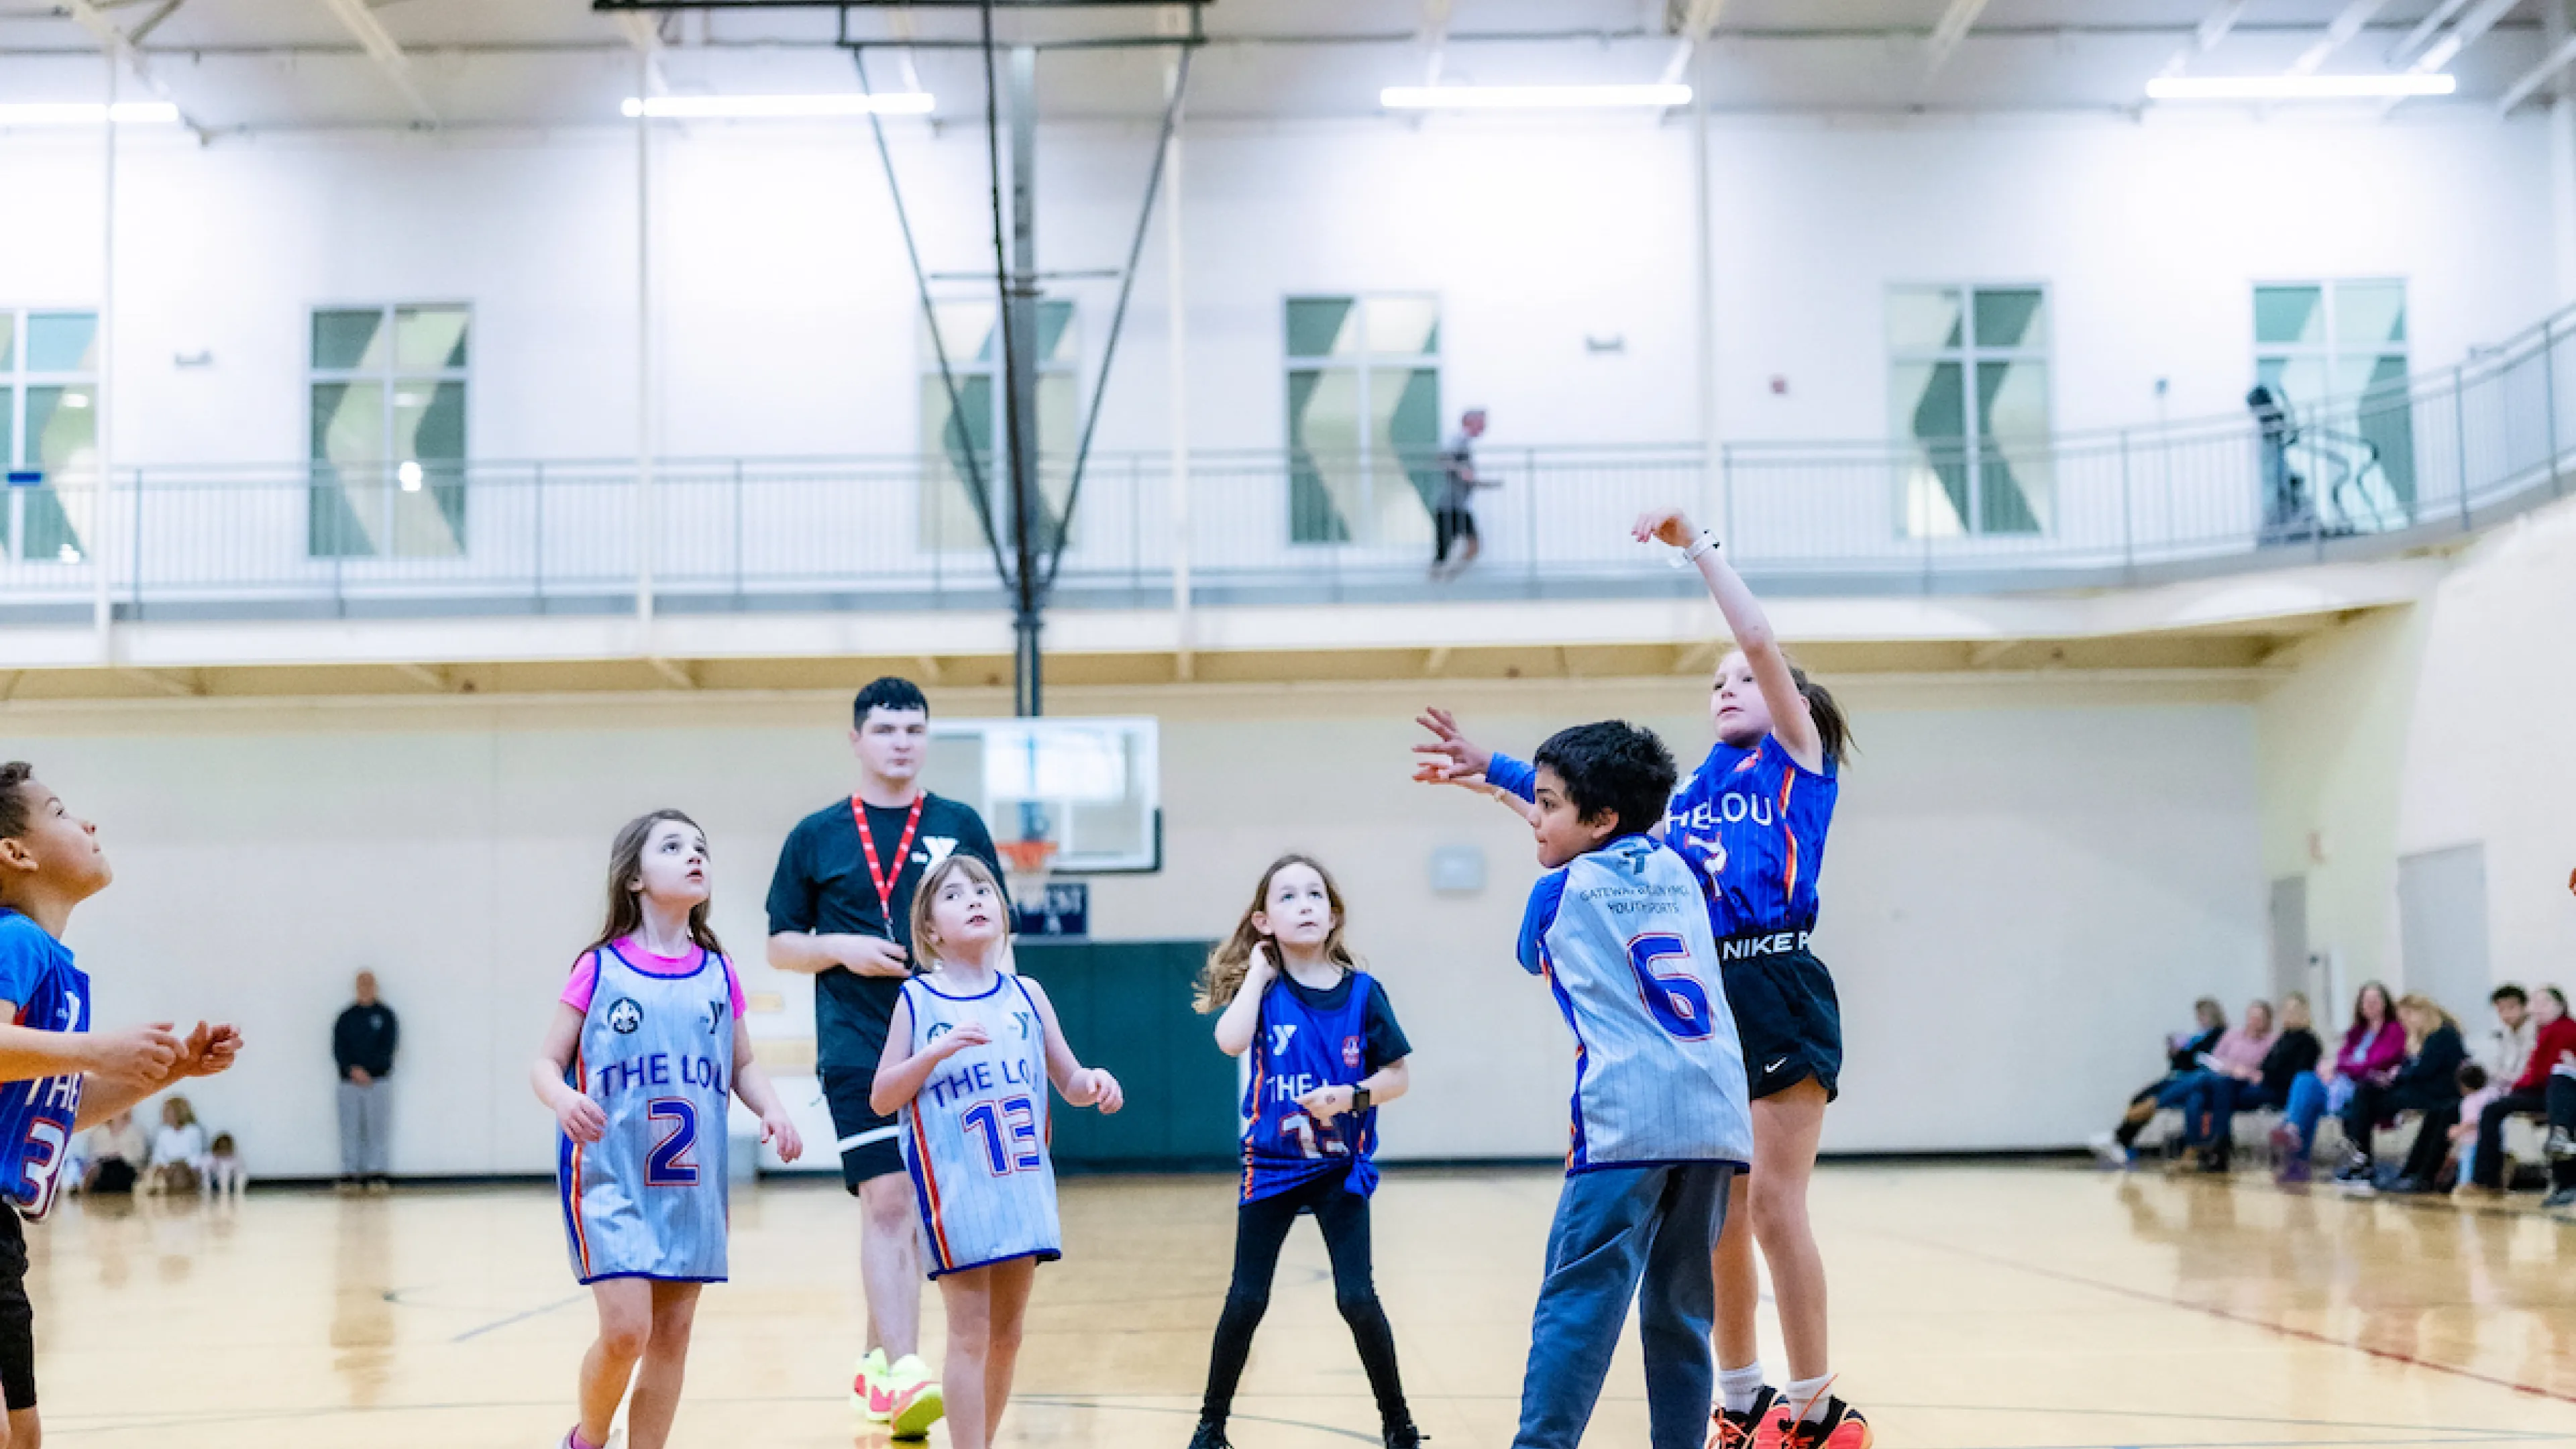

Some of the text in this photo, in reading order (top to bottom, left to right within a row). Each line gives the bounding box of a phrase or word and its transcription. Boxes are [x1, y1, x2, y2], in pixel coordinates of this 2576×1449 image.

[1627, 932, 1715, 1042] 6
[1723, 930, 1795, 961] NIKE
[596, 1053, 668, 1097] THE
[929, 1062, 993, 1108] THE
[21, 1116, 66, 1222] 3
[644, 1096, 700, 1187] 2
[961, 1093, 1040, 1178] 13
